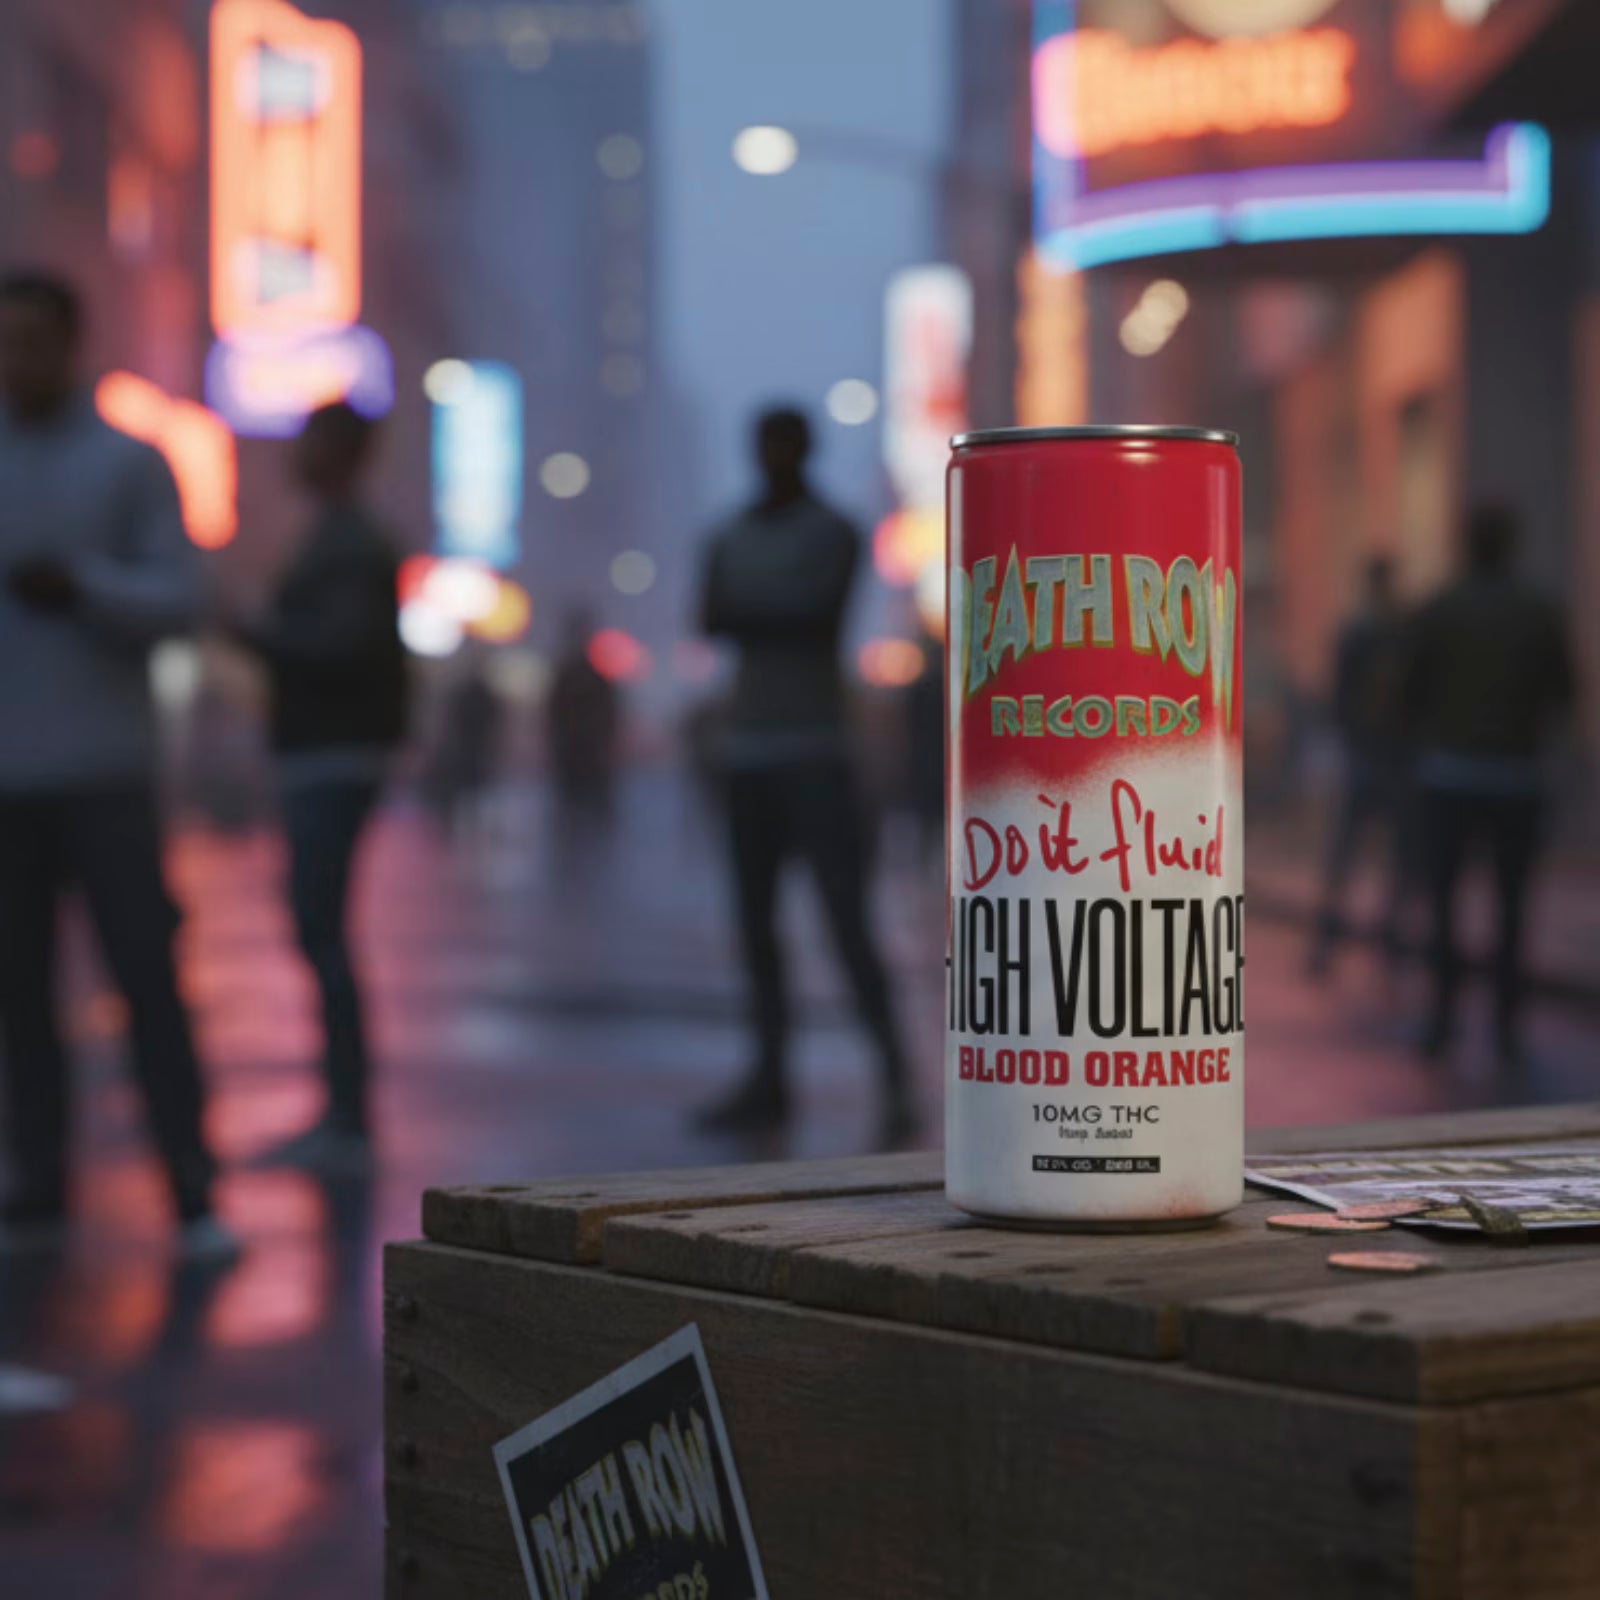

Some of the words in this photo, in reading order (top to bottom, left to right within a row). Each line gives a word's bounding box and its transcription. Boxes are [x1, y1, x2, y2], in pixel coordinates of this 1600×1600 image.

[1124, 555, 1236, 734] ROW
[991, 694, 1200, 738] RECORDS
[964, 817, 1029, 891] Do
[1100, 778, 1223, 892] fluid
[959, 1046, 1069, 1085] BLOOD
[1085, 1048, 1230, 1087] ORANGE
[1032, 1104, 1102, 1123] 10MG
[1110, 1105, 1160, 1123] THC
[621, 1406, 727, 1547] ROW
